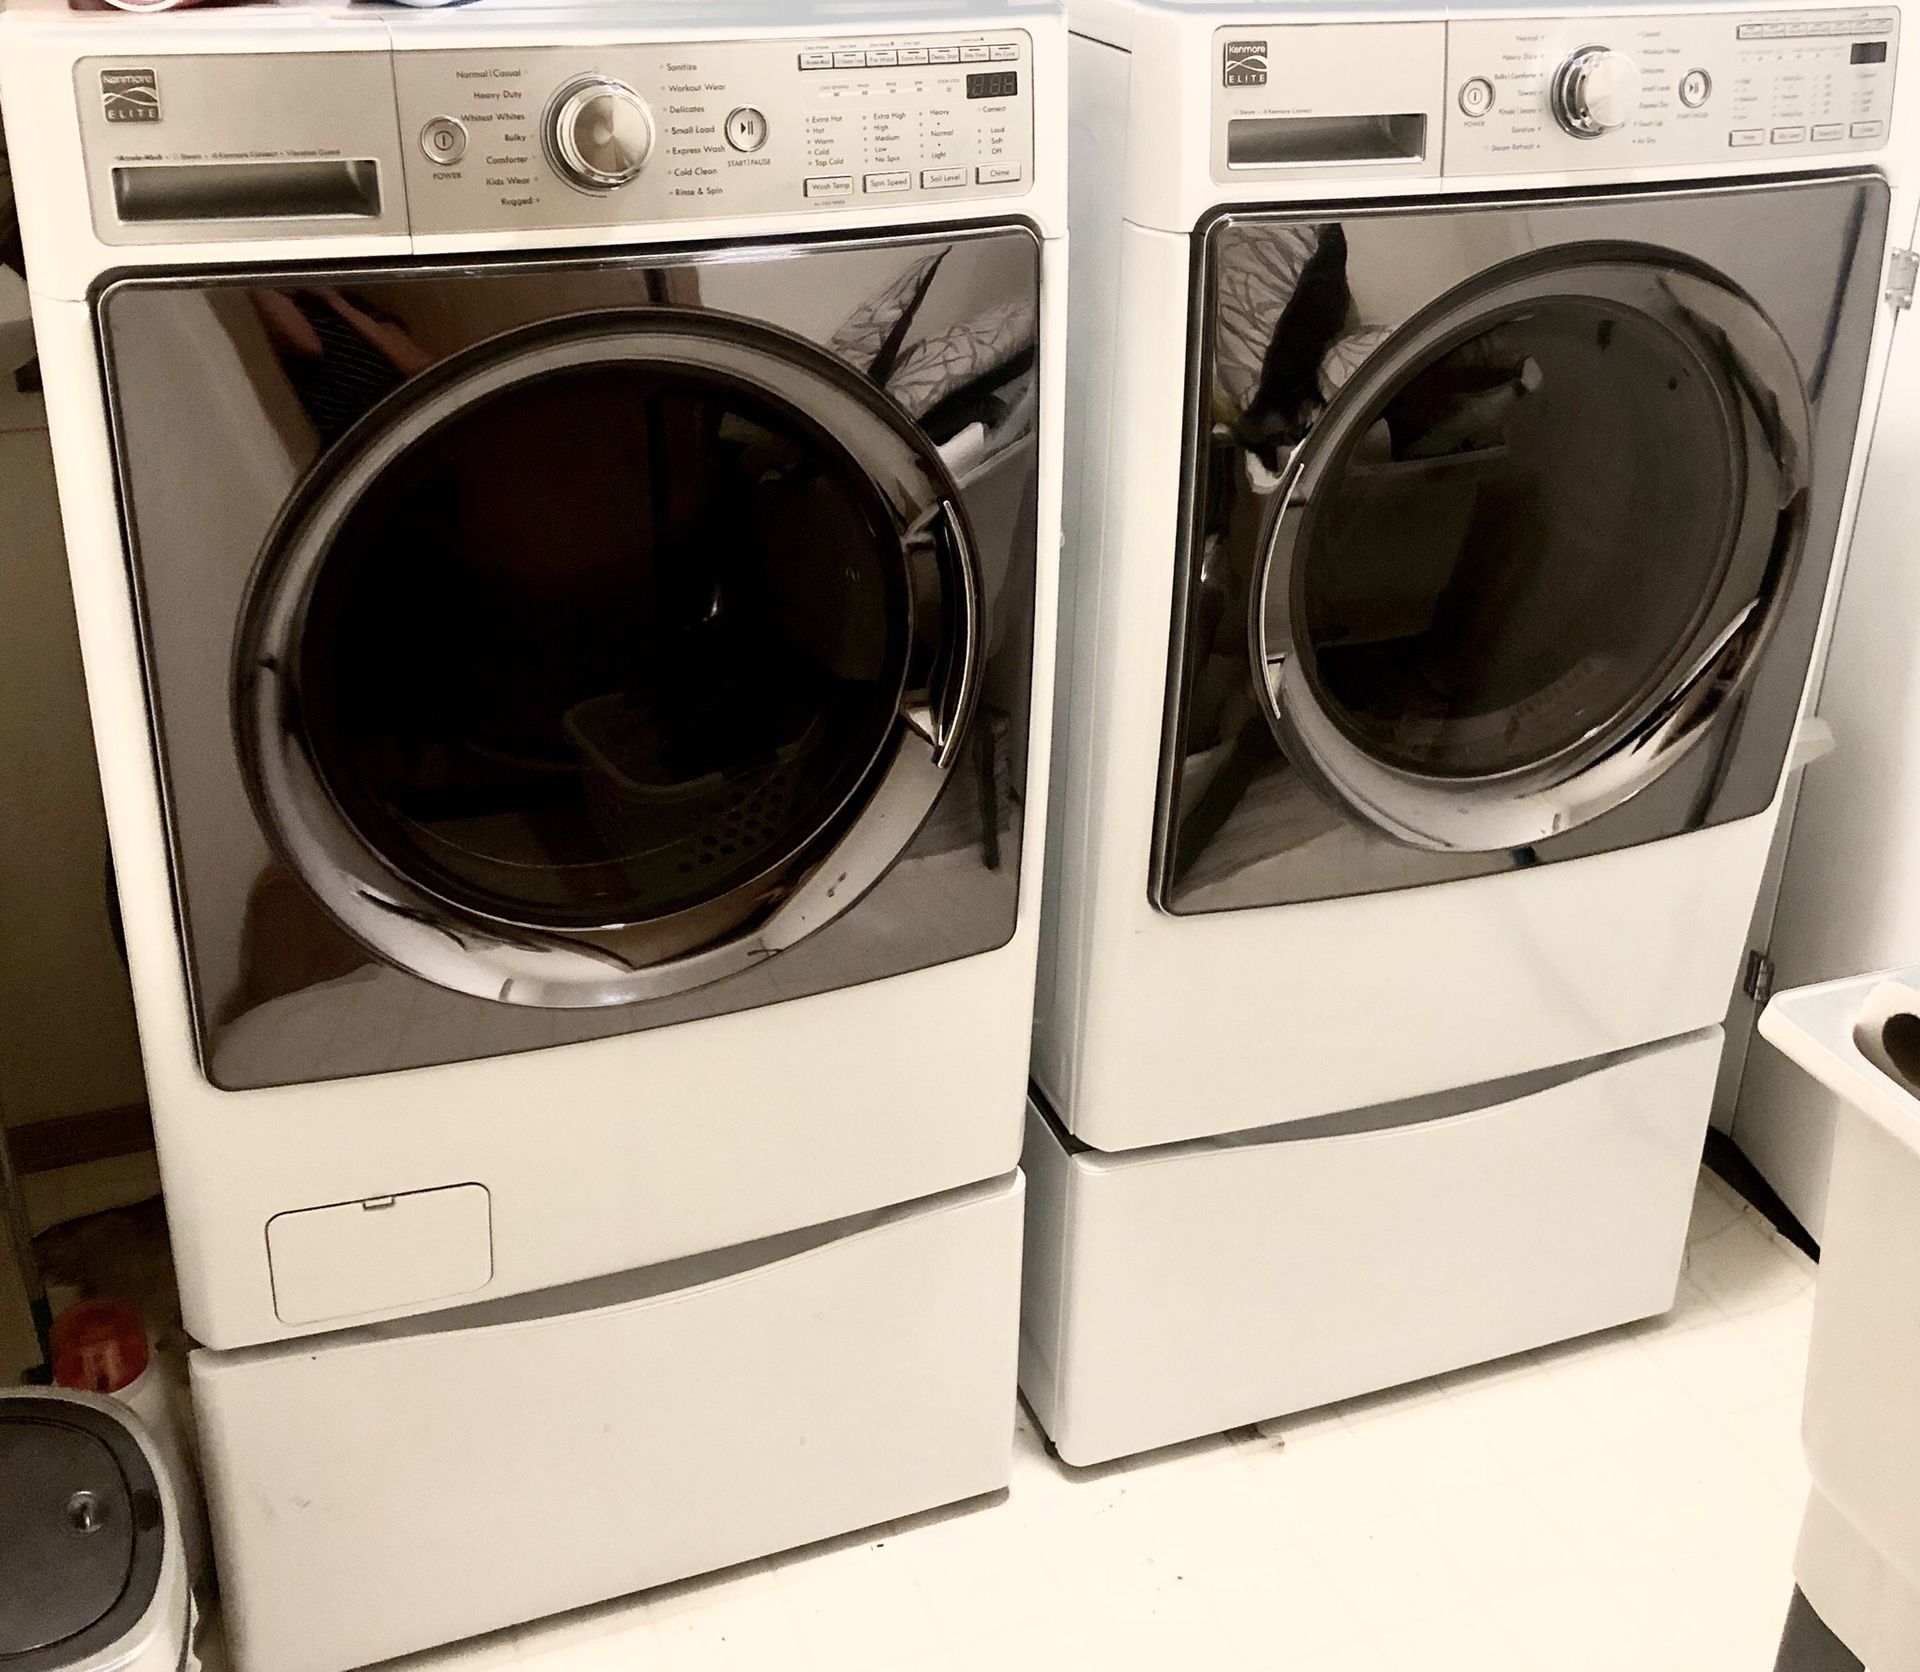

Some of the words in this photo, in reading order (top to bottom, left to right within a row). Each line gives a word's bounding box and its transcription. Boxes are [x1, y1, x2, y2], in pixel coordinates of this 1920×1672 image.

[1229, 46, 1265, 54] Kenmore
[666, 63, 697, 72] Sanitize
[1229, 75, 1265, 83] ELITE
[669, 84, 701, 92] Workout
[704, 83, 726, 91] Wear
[473, 91, 500, 100] Heavy
[503, 90, 522, 99] Duty
[108, 109, 156, 119] ELITE
[669, 105, 705, 114] Delicates
[461, 113, 493, 121] Whitest
[496, 112, 525, 120] Whites
[891, 112, 906, 120] High
[671, 126, 694, 135] Small
[695, 125, 715, 134] Load
[931, 129, 954, 137] Normal
[504, 133, 526, 142] Bulky
[672, 147, 701, 156] Express
[703, 145, 726, 153] Wash
[931, 151, 946, 159] Light
[486, 156, 528, 164] Comforter
[433, 171, 461, 180] POWER
[674, 167, 693, 176] Cold
[694, 167, 718, 176] Clean
[486, 177, 504, 185] Kids
[507, 176, 530, 184] Wear
[870, 179, 885, 187] Spin
[887, 179, 907, 187] Speed
[930, 175, 942, 183] Soil
[833, 182, 850, 190] Temp
[675, 188, 695, 196] Rinse
[697, 187, 703, 195] &
[706, 187, 723, 196] Spin
[501, 196, 533, 206] Rugged
